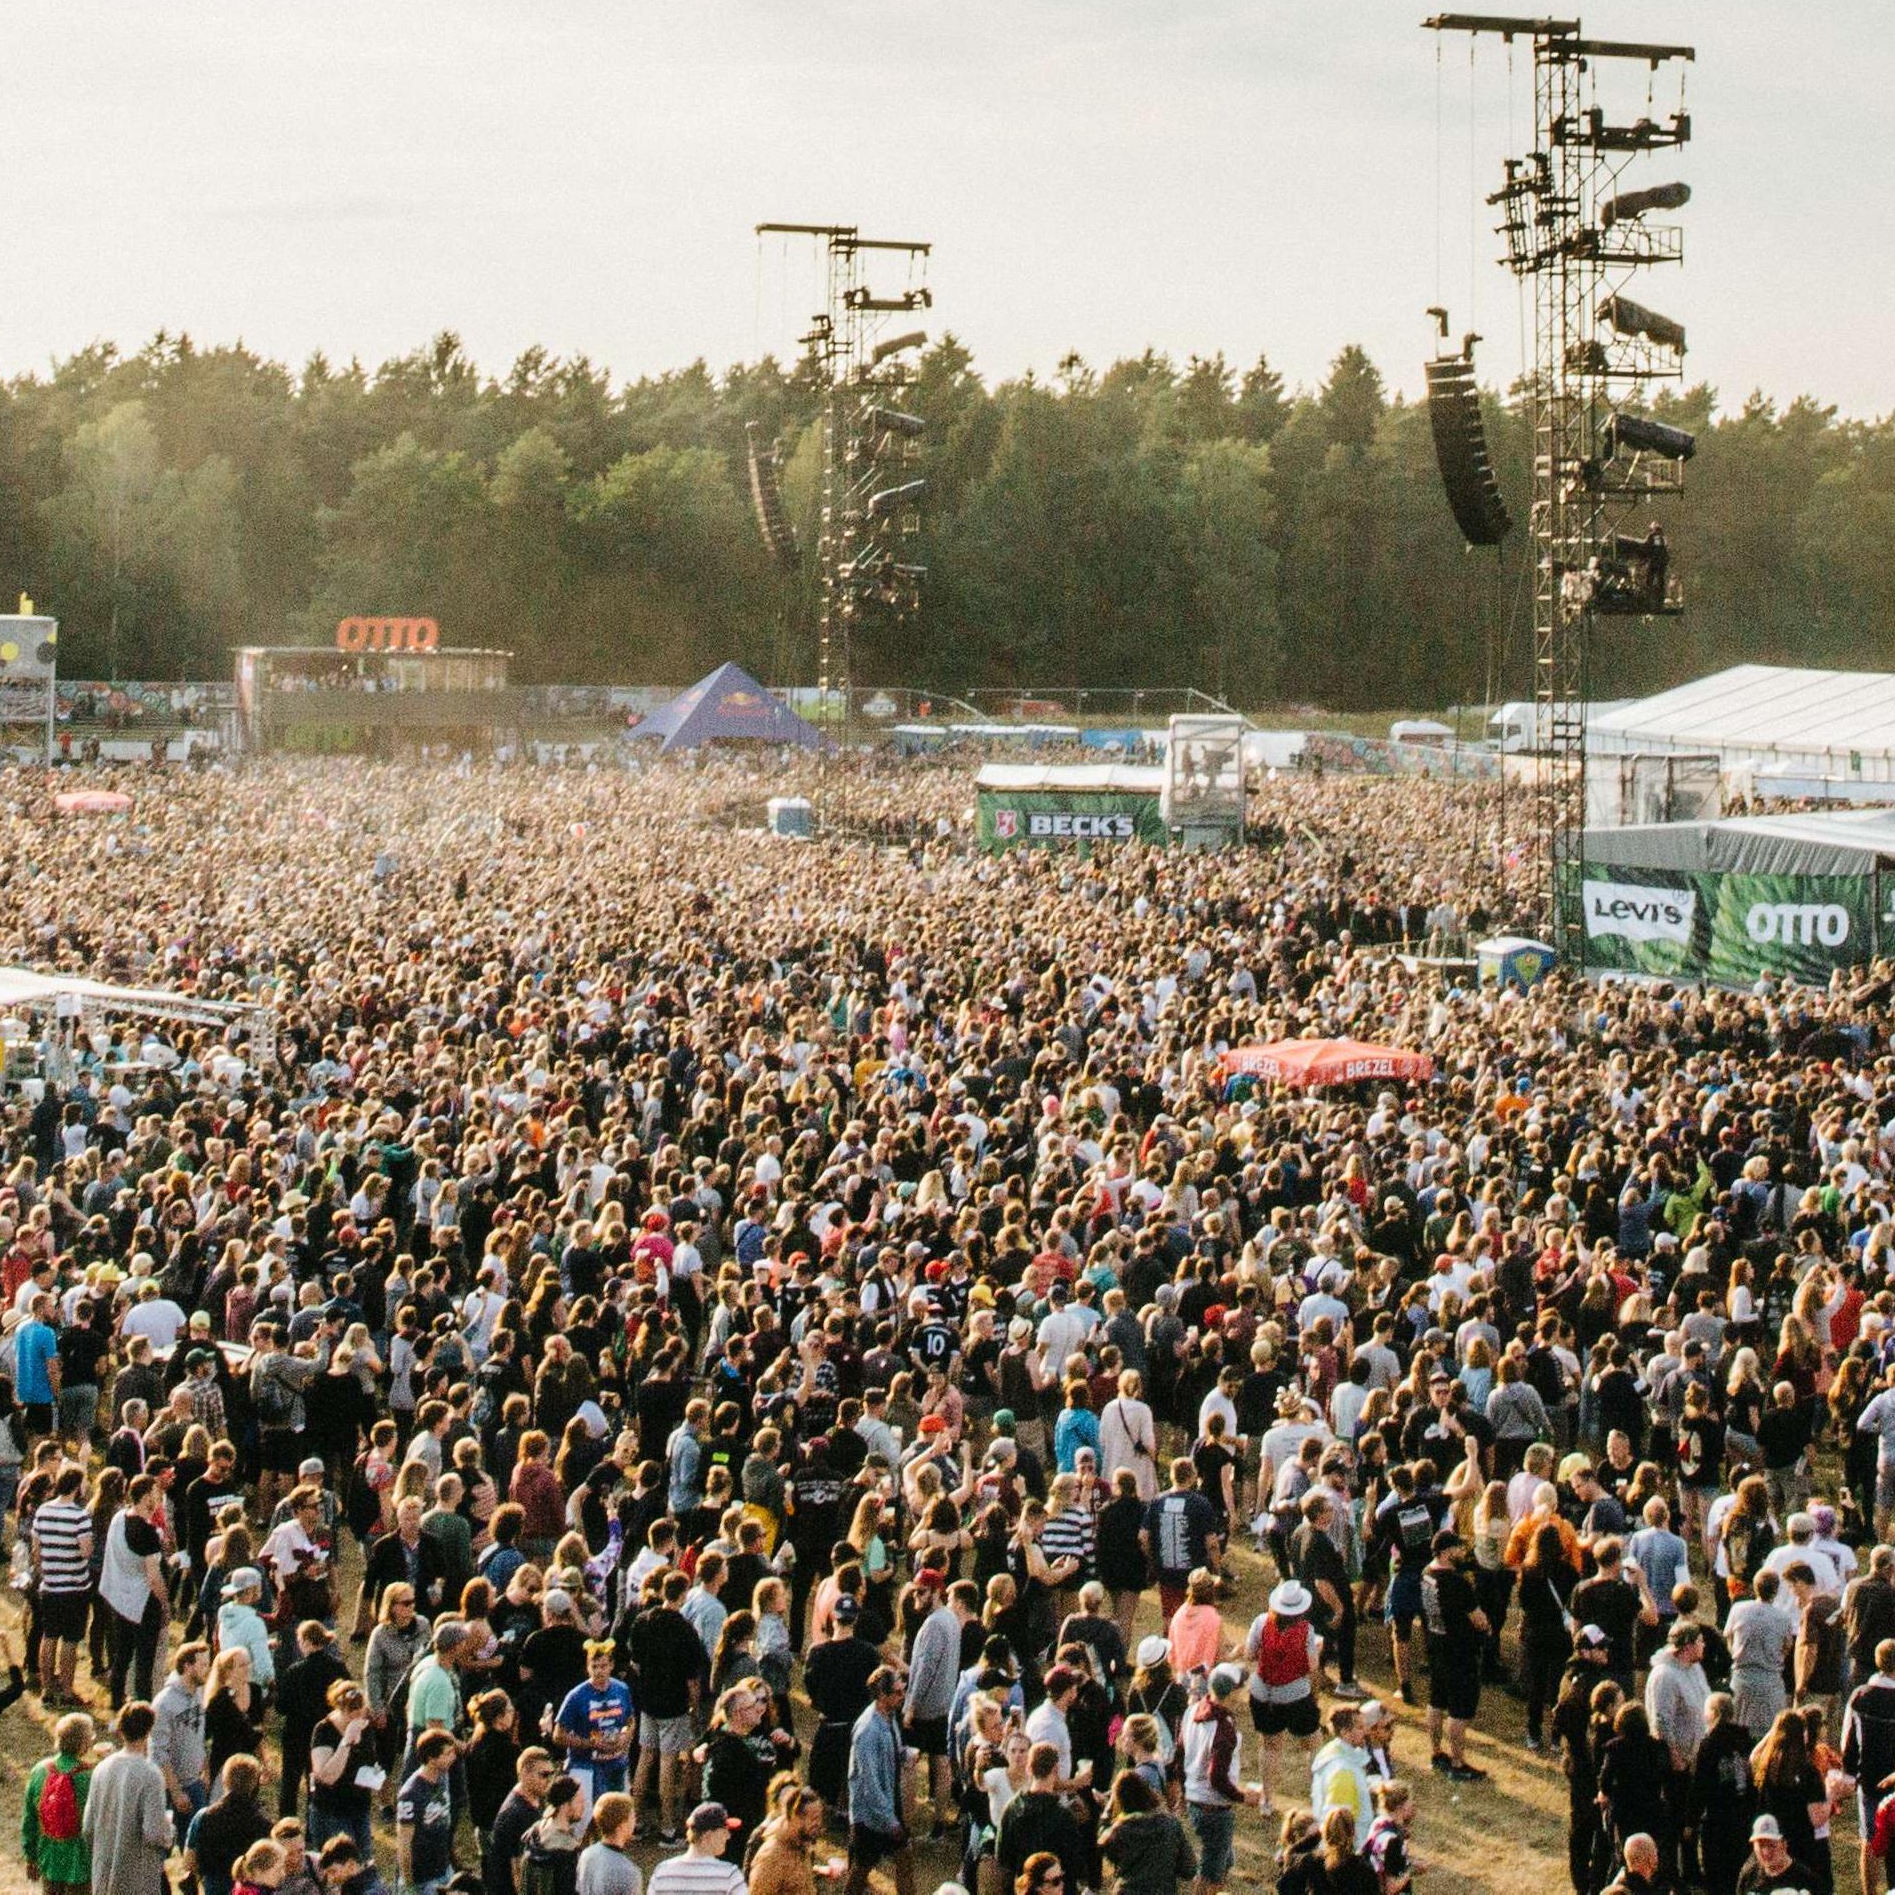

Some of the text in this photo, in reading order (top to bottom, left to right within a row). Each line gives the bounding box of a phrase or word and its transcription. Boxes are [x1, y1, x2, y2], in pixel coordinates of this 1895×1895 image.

[337, 616, 438, 652] OTTO
[1030, 812, 1133, 836] BECK'S
[1594, 898, 1683, 925] Levi's
[1746, 902, 1850, 947] OTTO
[1346, 1058, 1395, 1079] BREZEL
[927, 1333, 945, 1356] 10
